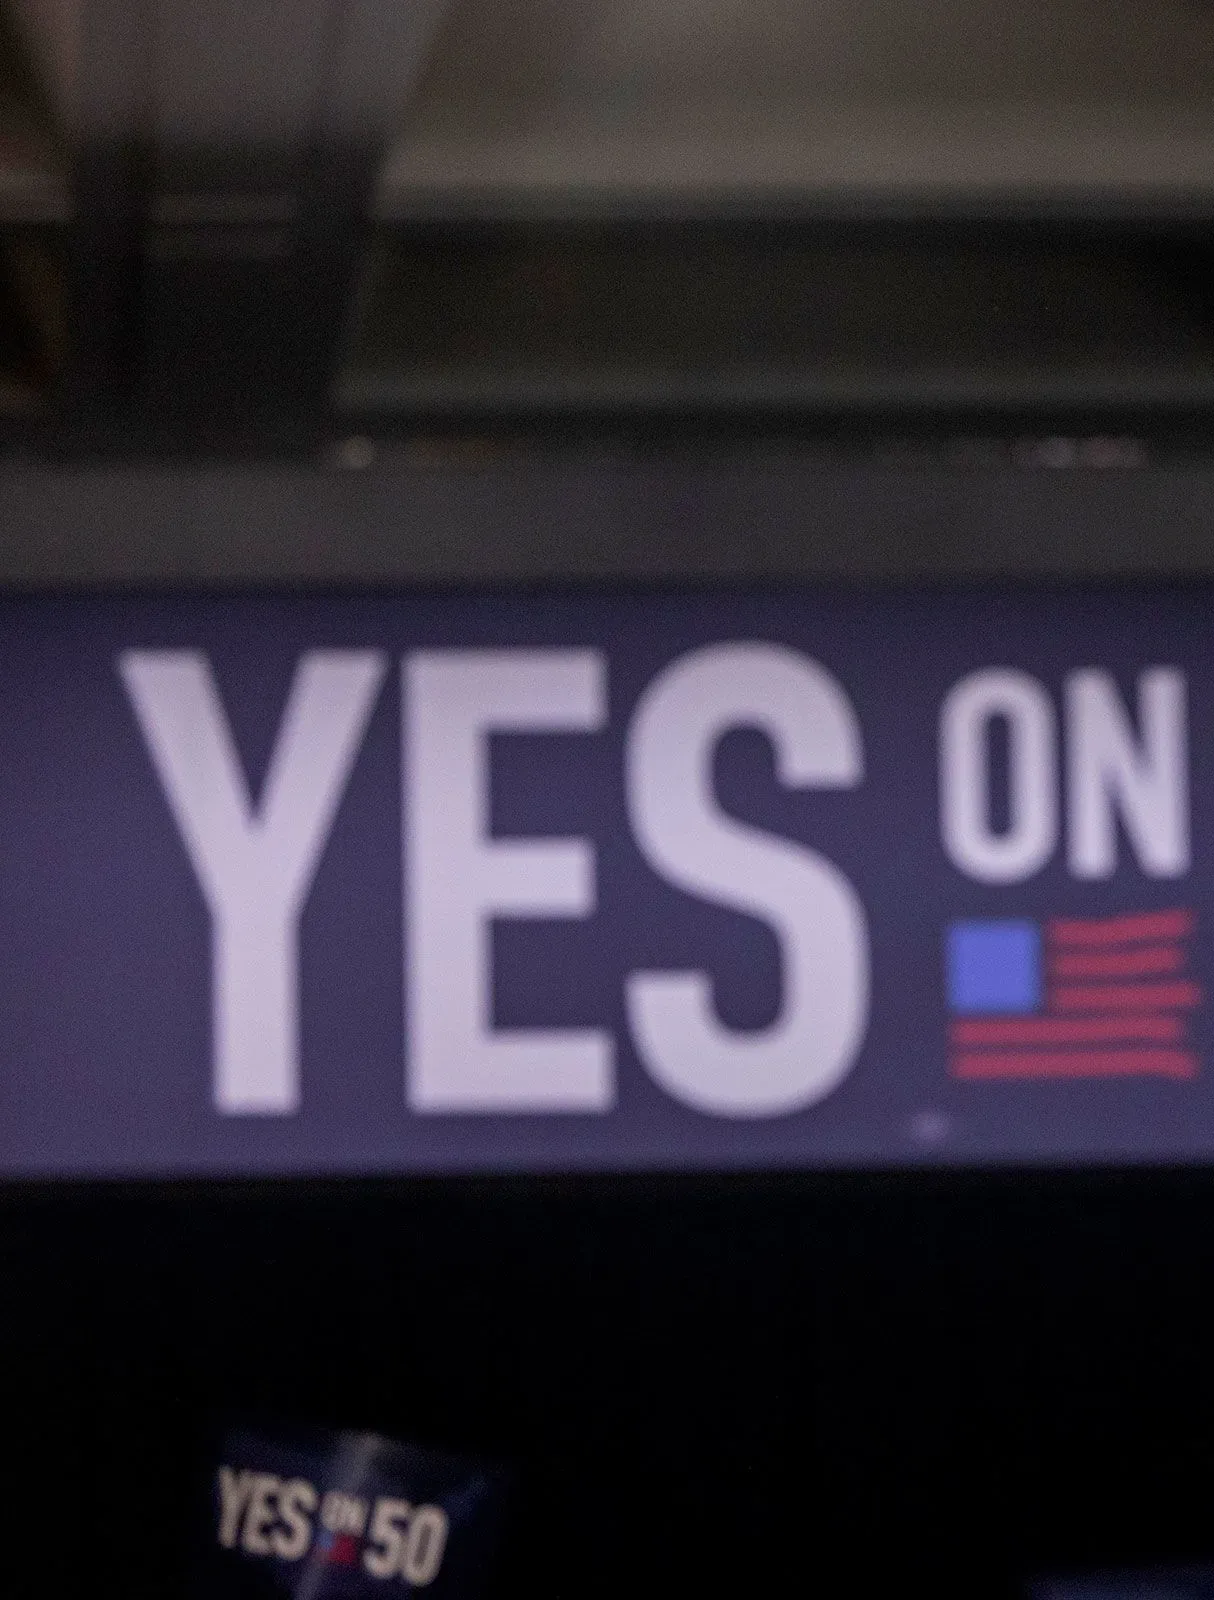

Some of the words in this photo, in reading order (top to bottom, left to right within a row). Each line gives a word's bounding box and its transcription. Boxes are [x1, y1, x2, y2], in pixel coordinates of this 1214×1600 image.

[118, 641, 872, 1119] YES
[940, 665, 1190, 885] ON
[217, 1464, 319, 1562] YES
[362, 1496, 449, 1588] 50
